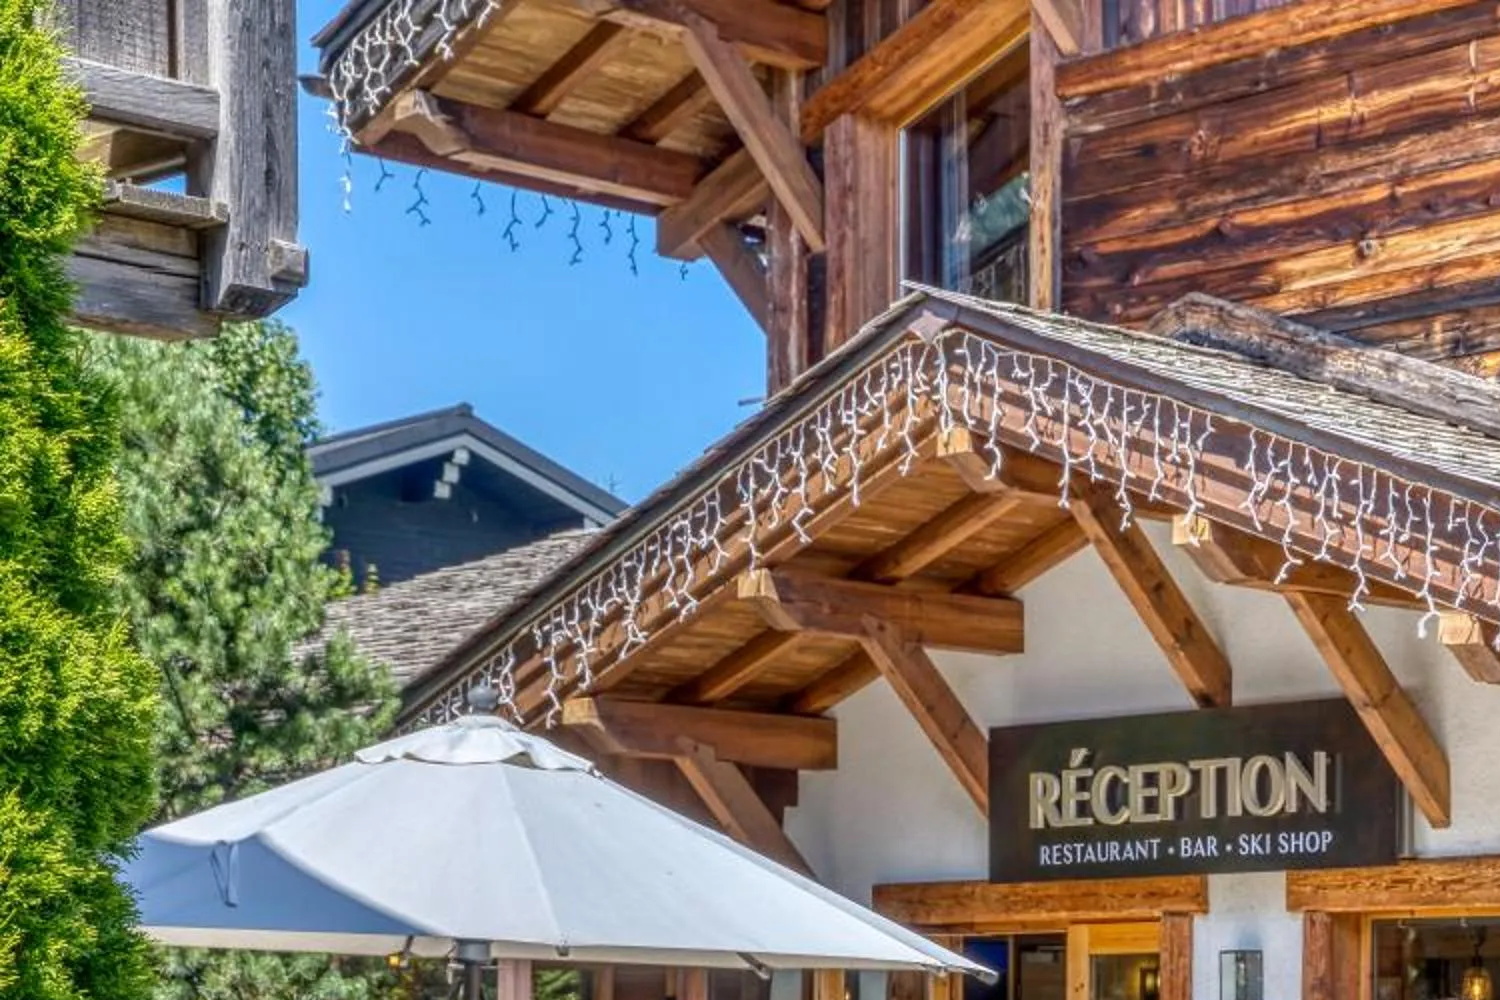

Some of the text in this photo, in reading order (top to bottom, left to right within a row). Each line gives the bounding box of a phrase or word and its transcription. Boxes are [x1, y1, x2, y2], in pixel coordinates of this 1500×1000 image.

[1029, 748, 1327, 830] RÉCEPTION
[1039, 830, 1333, 866] RESTAURANT BAR SKI SHOP
